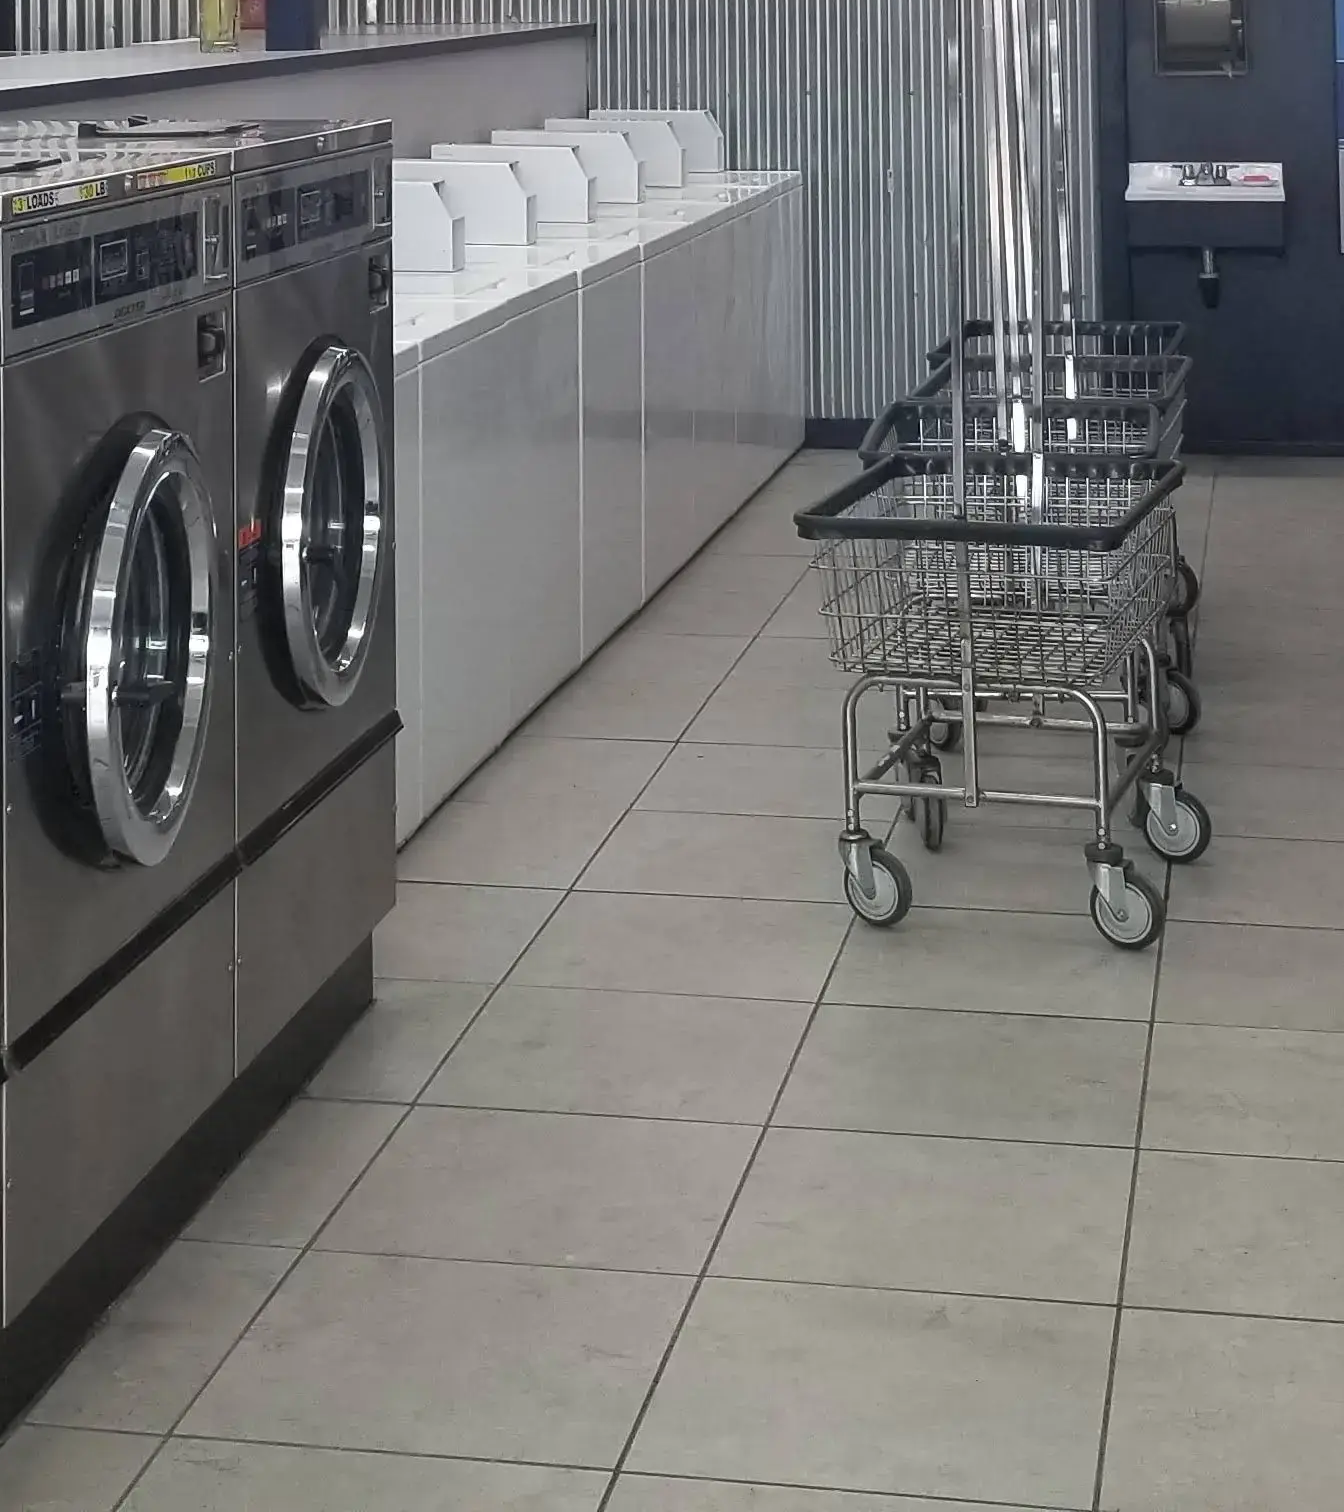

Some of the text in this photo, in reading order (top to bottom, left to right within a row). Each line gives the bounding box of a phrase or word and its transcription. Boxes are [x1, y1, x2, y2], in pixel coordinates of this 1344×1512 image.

[197, 161, 216, 179] CUPS
[26, 191, 55, 211] LOADS
[94, 181, 105, 196] LB
